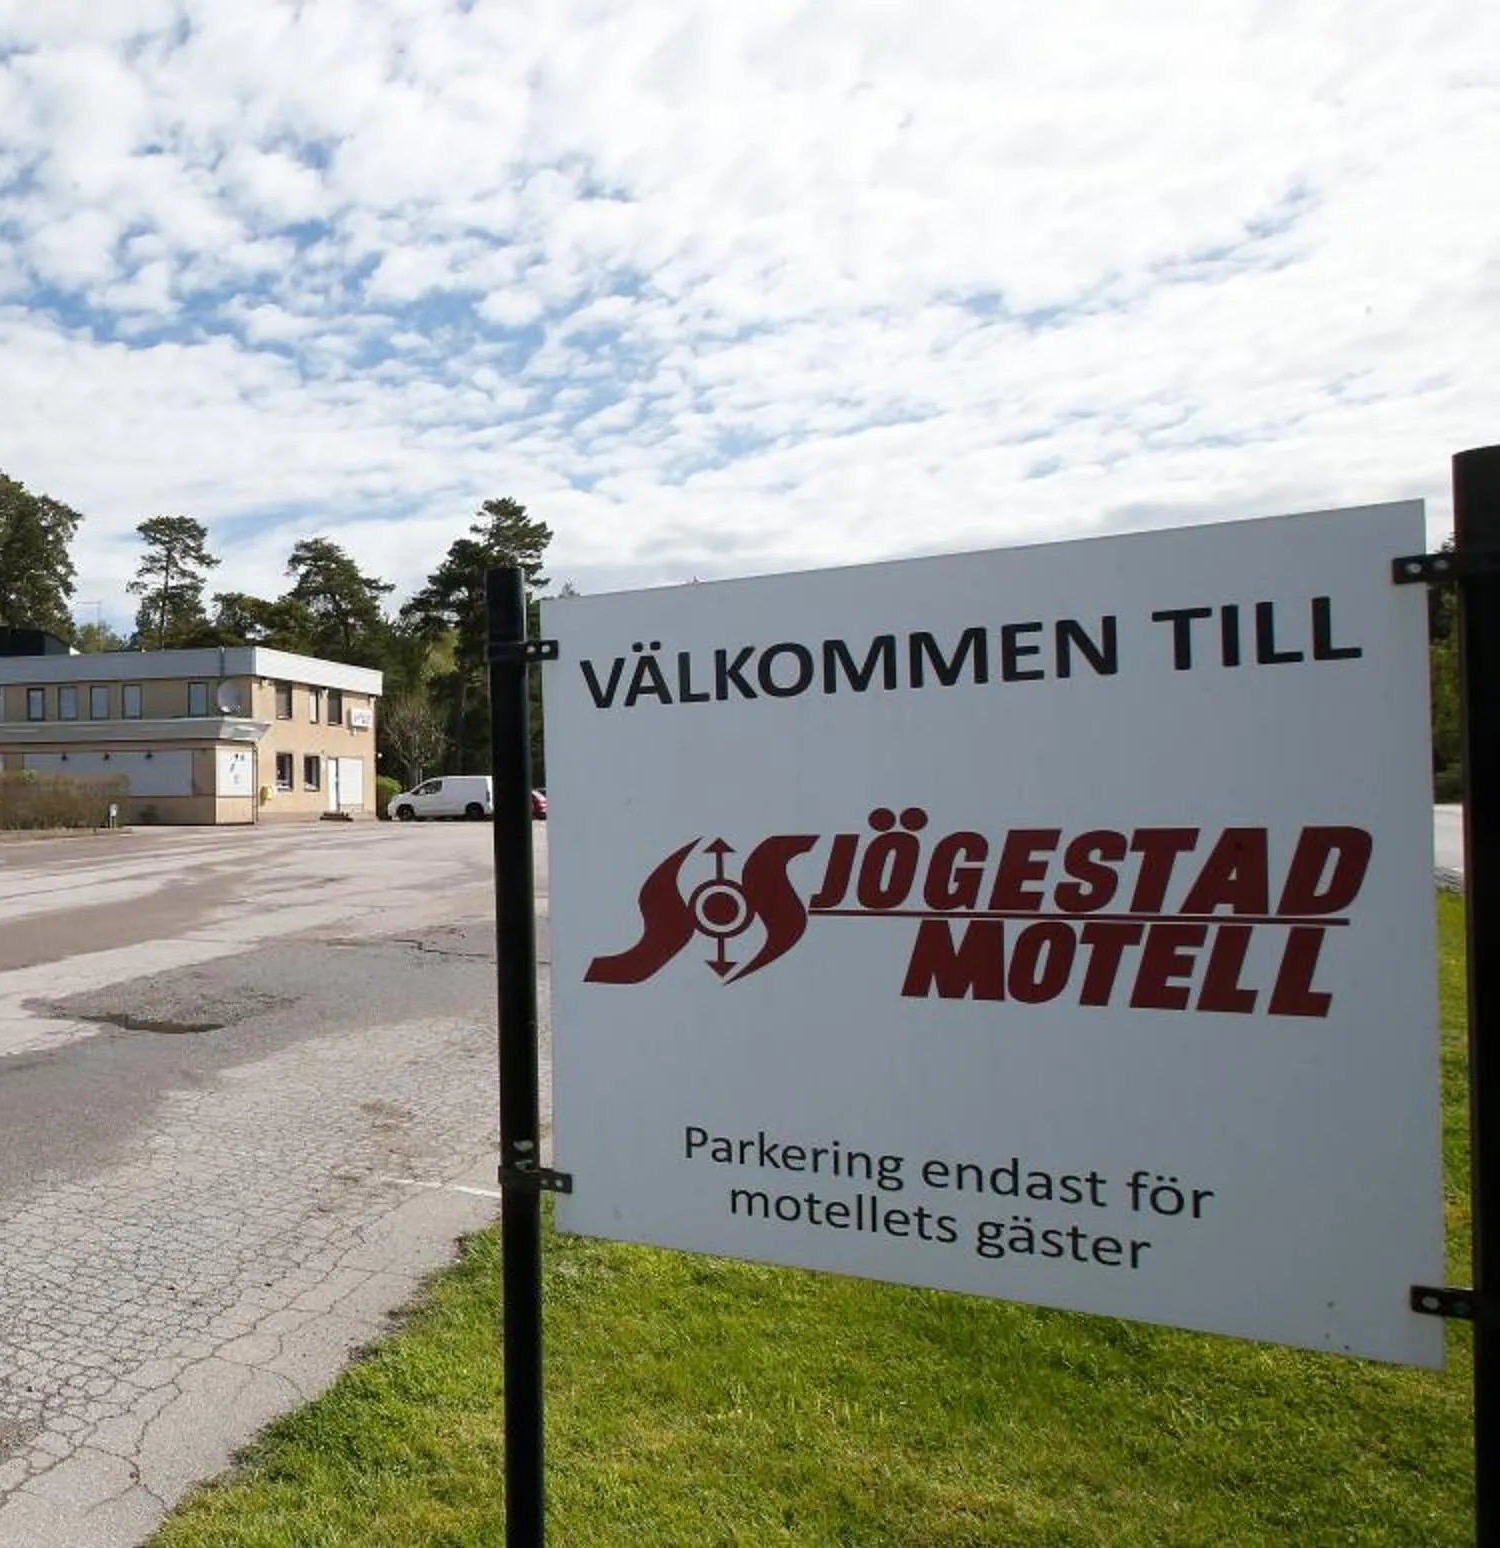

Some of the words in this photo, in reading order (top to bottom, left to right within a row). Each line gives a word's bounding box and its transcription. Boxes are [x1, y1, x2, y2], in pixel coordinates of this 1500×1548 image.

[579, 615, 1119, 709] VÄLKOMMEN
[1151, 595, 1364, 671] TILL
[900, 920, 1333, 1018] MOTELL
[685, 1125, 905, 1193] Parkering
[921, 1156, 1110, 1209] endast
[1124, 1168, 1220, 1221] för
[729, 1188, 960, 1245] motellets
[974, 1214, 1153, 1271] gäster
